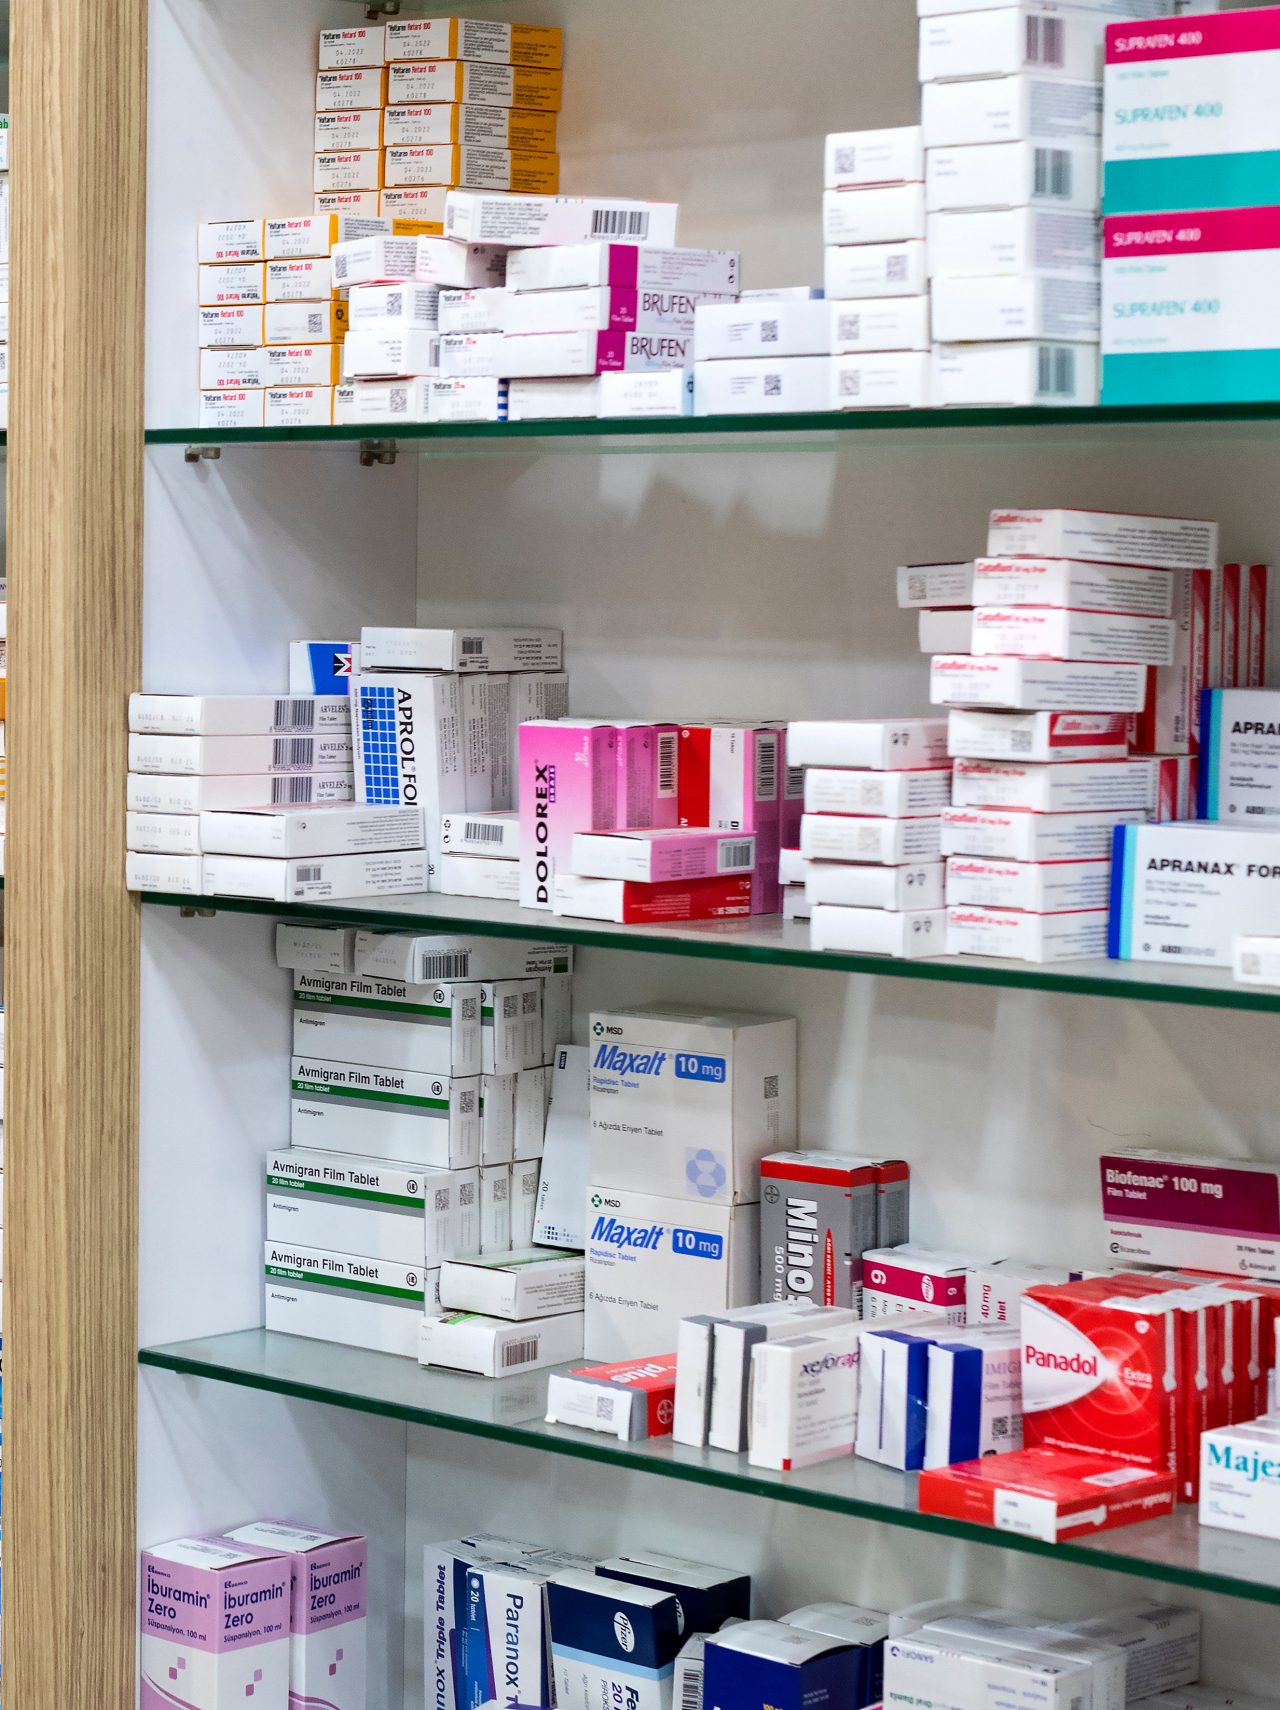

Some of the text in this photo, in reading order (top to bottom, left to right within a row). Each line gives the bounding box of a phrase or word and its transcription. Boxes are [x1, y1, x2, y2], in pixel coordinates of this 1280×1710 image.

[1194, 101, 1223, 118] 400
[303, 219, 311, 227] 100
[642, 292, 695, 316] BRUFEN
[630, 336, 686, 360] BRUFEN
[397, 687, 416, 770] APROL
[1231, 721, 1280, 735] APRA
[535, 764, 548, 904] DOLOREX
[1147, 857, 1280, 879] APRANAX FOR
[299, 974, 407, 998] Avmigran Film Tablet
[606, 1026, 623, 1035] MSD
[593, 1043, 723, 1080] Maxalt 10 mg
[297, 1065, 405, 1090] Avmigran Film Tablet
[314, 1085, 331, 1093] tablet
[593, 1076, 640, 1089] Rapidisc Tablet
[598, 1121, 621, 1132] Ağızda
[644, 1127, 664, 1137] Tablet
[272, 1160, 380, 1187] Avmigran Film Tablet
[1105, 1168, 1223, 1199] Biofenac 100 mg
[604, 1198, 621, 1208] MSD
[1106, 1187, 1148, 1200] Film Tablet
[590, 1216, 719, 1257] Maxalt 10 mg
[270, 1250, 379, 1279] Avmigran Film Tablet
[773, 1245, 785, 1303] 500 mg
[798, 1351, 860, 1377] xeforap
[1025, 1345, 1098, 1377] Panadol
[1123, 1367, 1152, 1383] Extra
[309, 1564, 360, 1592] İburamin
[147, 1574, 208, 1609] İburamin
[223, 1583, 283, 1610] İburamin
[310, 1591, 337, 1611] Zero
[147, 1597, 177, 1619] Zero
[436, 1564, 446, 1661] Triple Tablet
[224, 1611, 254, 1630] Zero
[275, 1622, 282, 1632] ml
[618, 1612, 631, 1651] Pfizer
[198, 1632, 207, 1642] ml
[506, 1592, 524, 1688] Paranox
